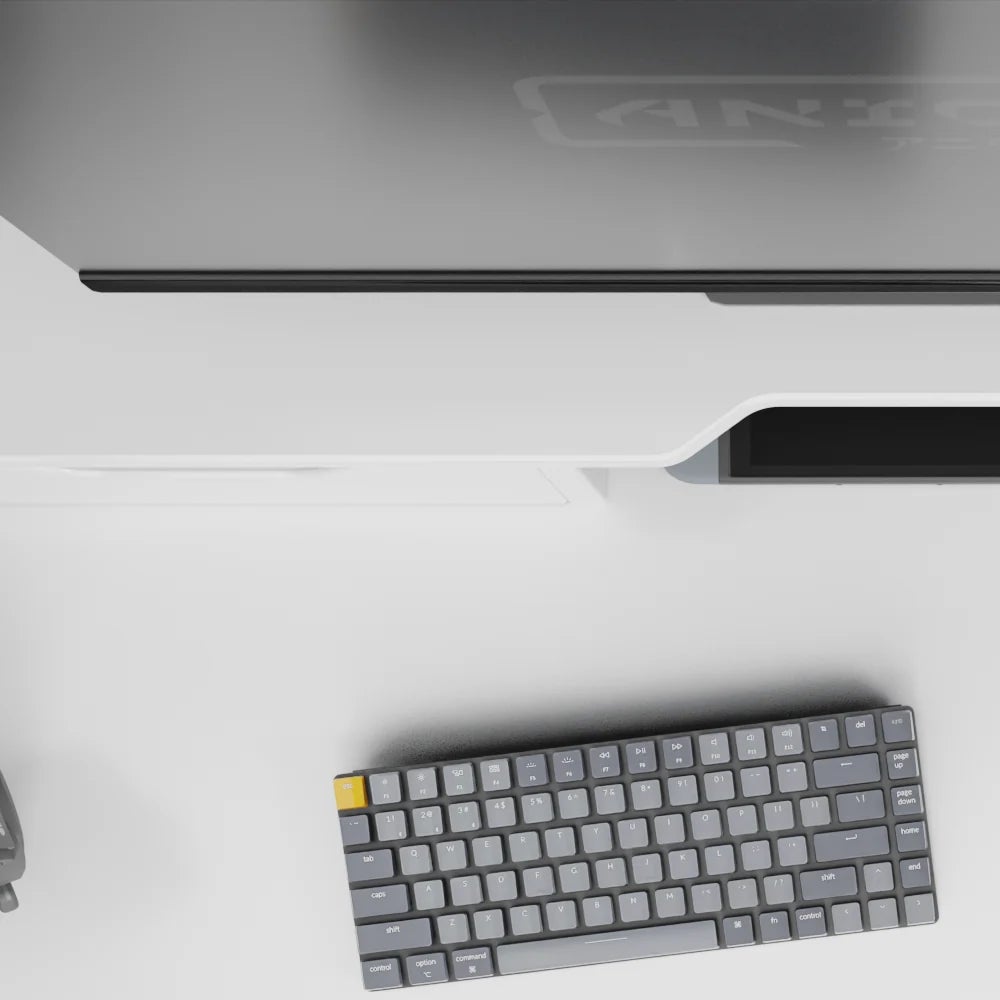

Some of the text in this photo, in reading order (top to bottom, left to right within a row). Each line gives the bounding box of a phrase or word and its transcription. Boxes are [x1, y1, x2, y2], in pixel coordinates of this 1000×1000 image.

[855, 720, 866, 729] del
[893, 752, 910, 761] page
[896, 789, 913, 798] page
[897, 798, 916, 806] down
[900, 827, 920, 835] home
[362, 855, 374, 863] tab
[908, 862, 921, 871] end
[820, 872, 836, 882] shift
[370, 891, 386, 899] caps
[770, 916, 778, 924] fn
[799, 912, 822, 921] control
[385, 925, 401, 934] shift
[455, 951, 487, 962] command
[415, 958, 437, 968] option
[369, 963, 392, 973] control
